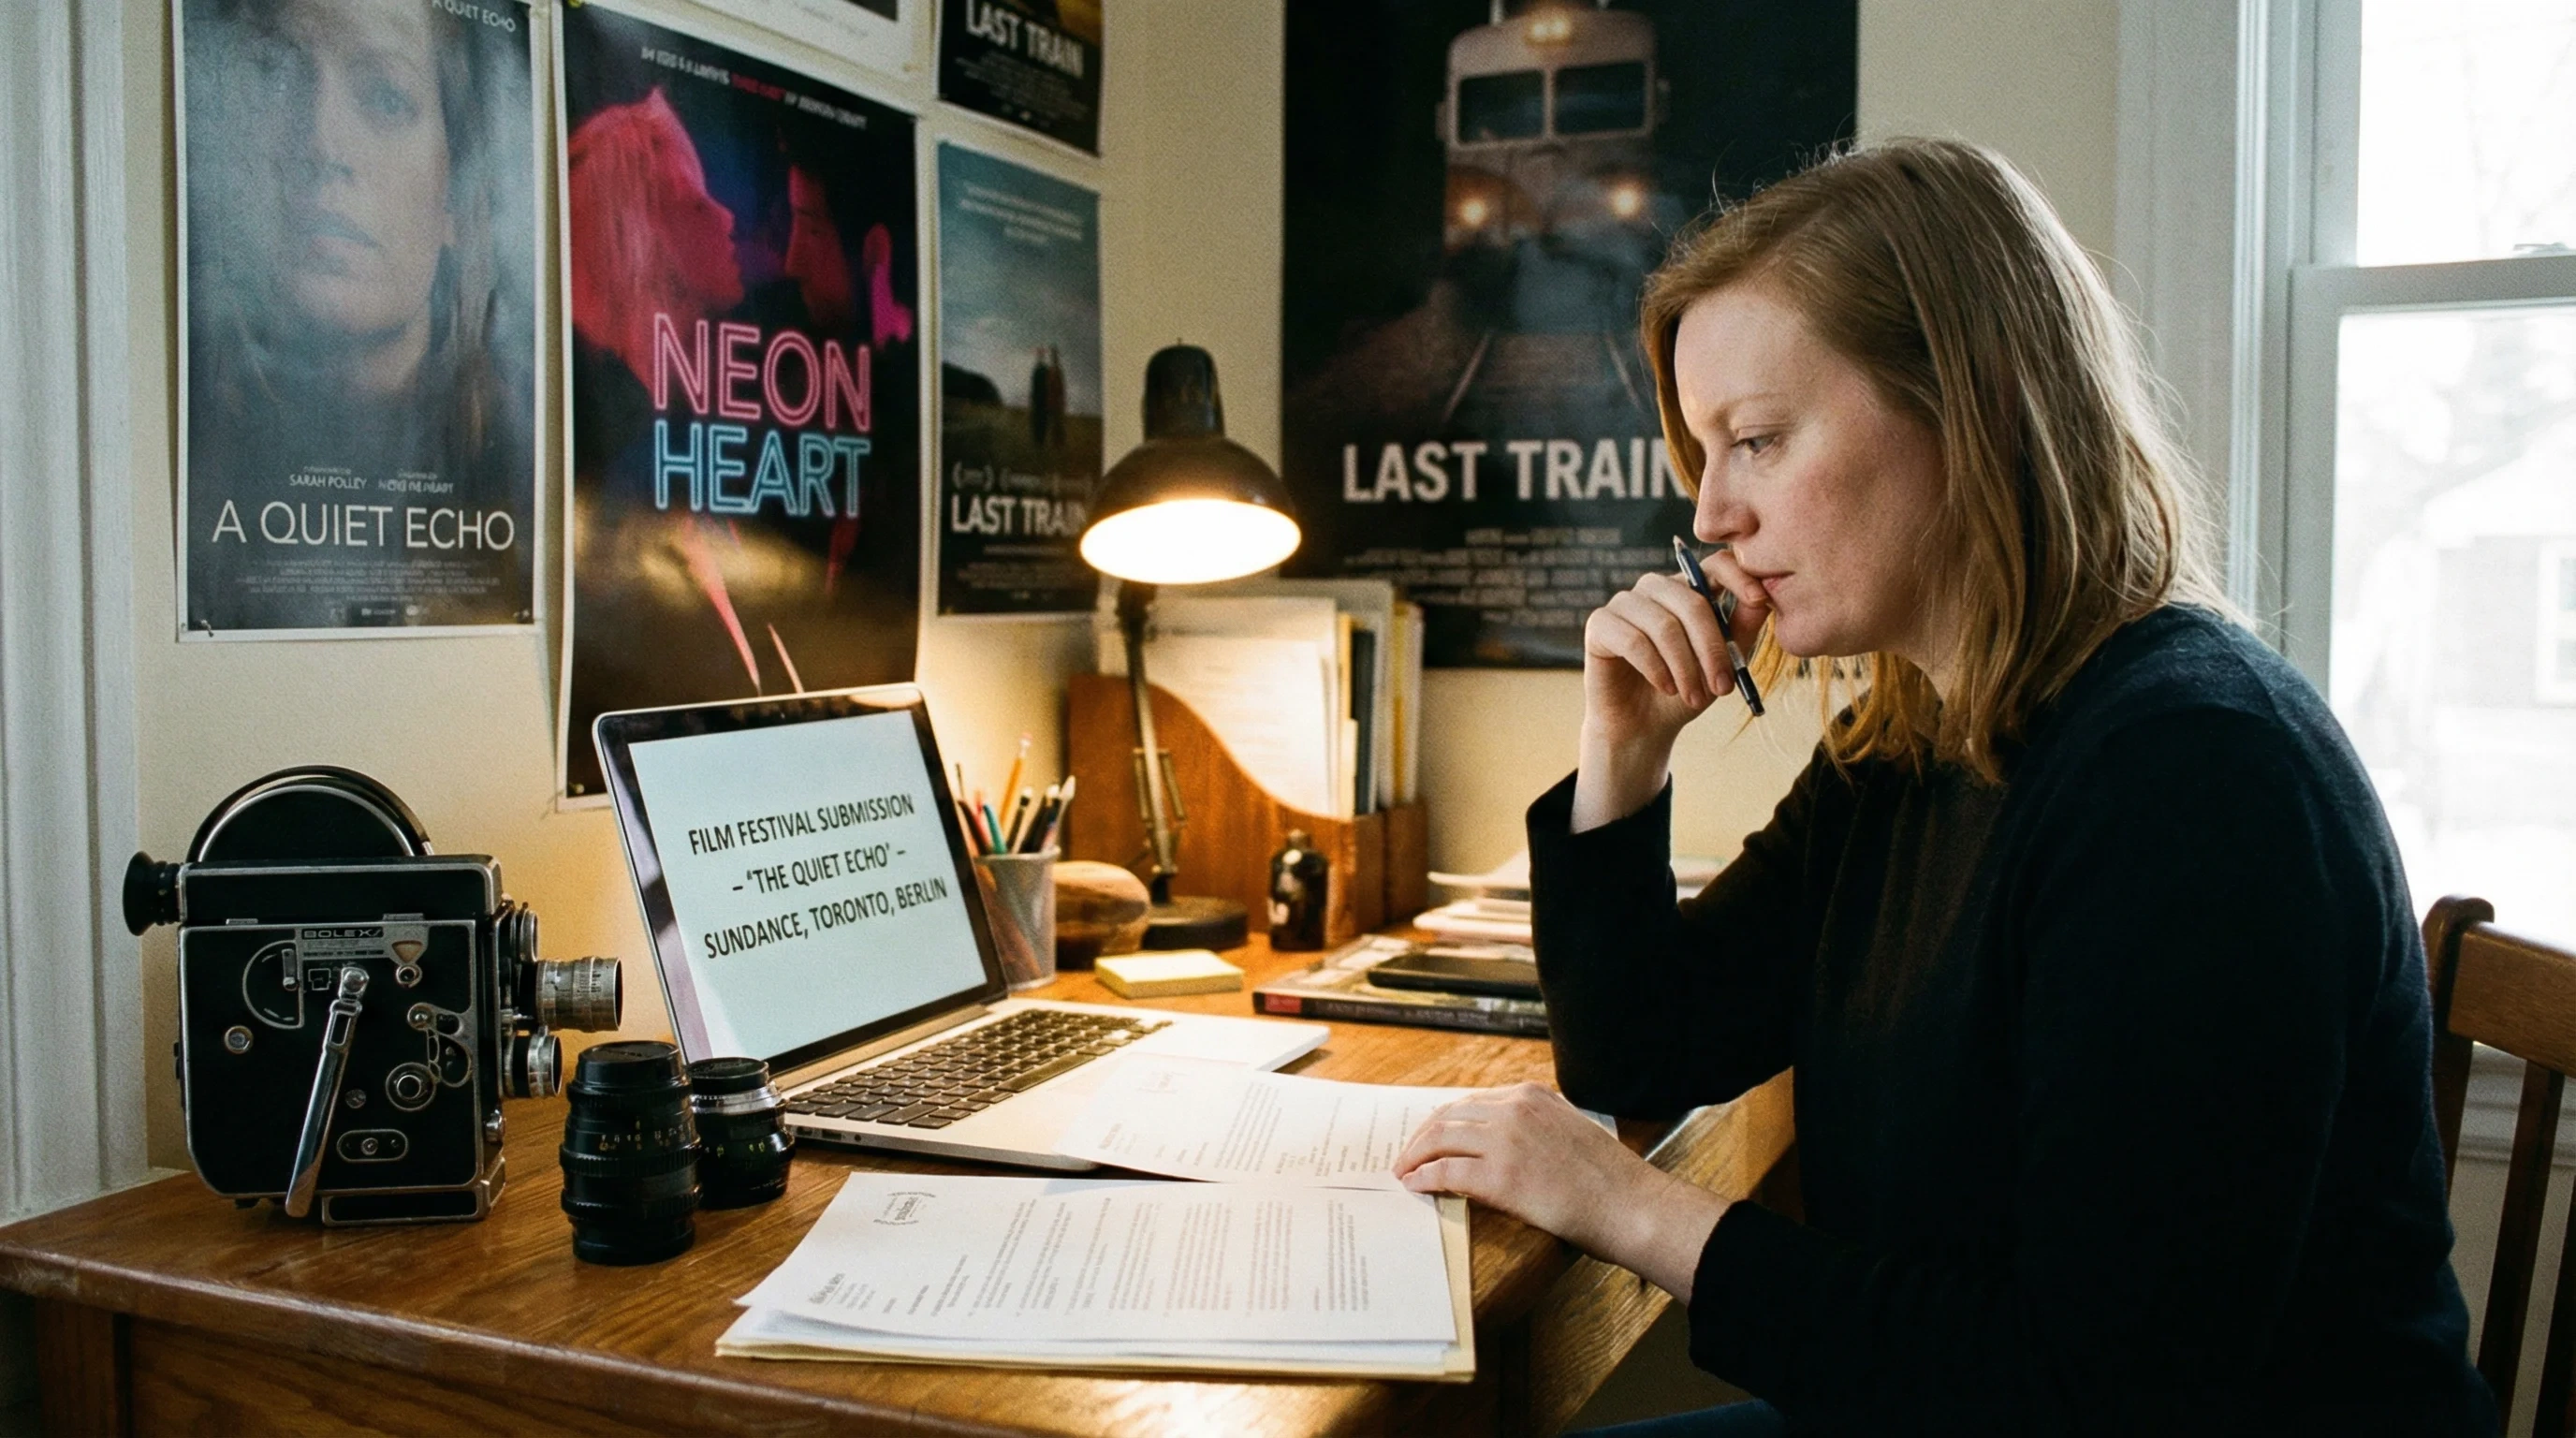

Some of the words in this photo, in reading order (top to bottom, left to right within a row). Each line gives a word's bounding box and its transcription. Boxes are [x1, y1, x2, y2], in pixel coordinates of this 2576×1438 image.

[966, 0, 1021, 51] LAST
[654, 312, 871, 433] NEON
[654, 419, 871, 519] HEART
[1342, 440, 1488, 503] LAST
[212, 499, 247, 543] A
[260, 501, 393, 547] QUIET
[406, 507, 515, 550] ECHO
[951, 494, 1017, 535] LAST
[688, 824, 735, 855] FILM
[737, 811, 816, 846] FESTIVAL
[817, 793, 915, 831] SUBMISSION
[792, 853, 841, 887] QUIET
[303, 929, 373, 939] BOLEX
[704, 912, 808, 959] SUNDANCE,
[809, 890, 895, 932] TORONTO,
[895, 876, 947, 910] BERLIN
